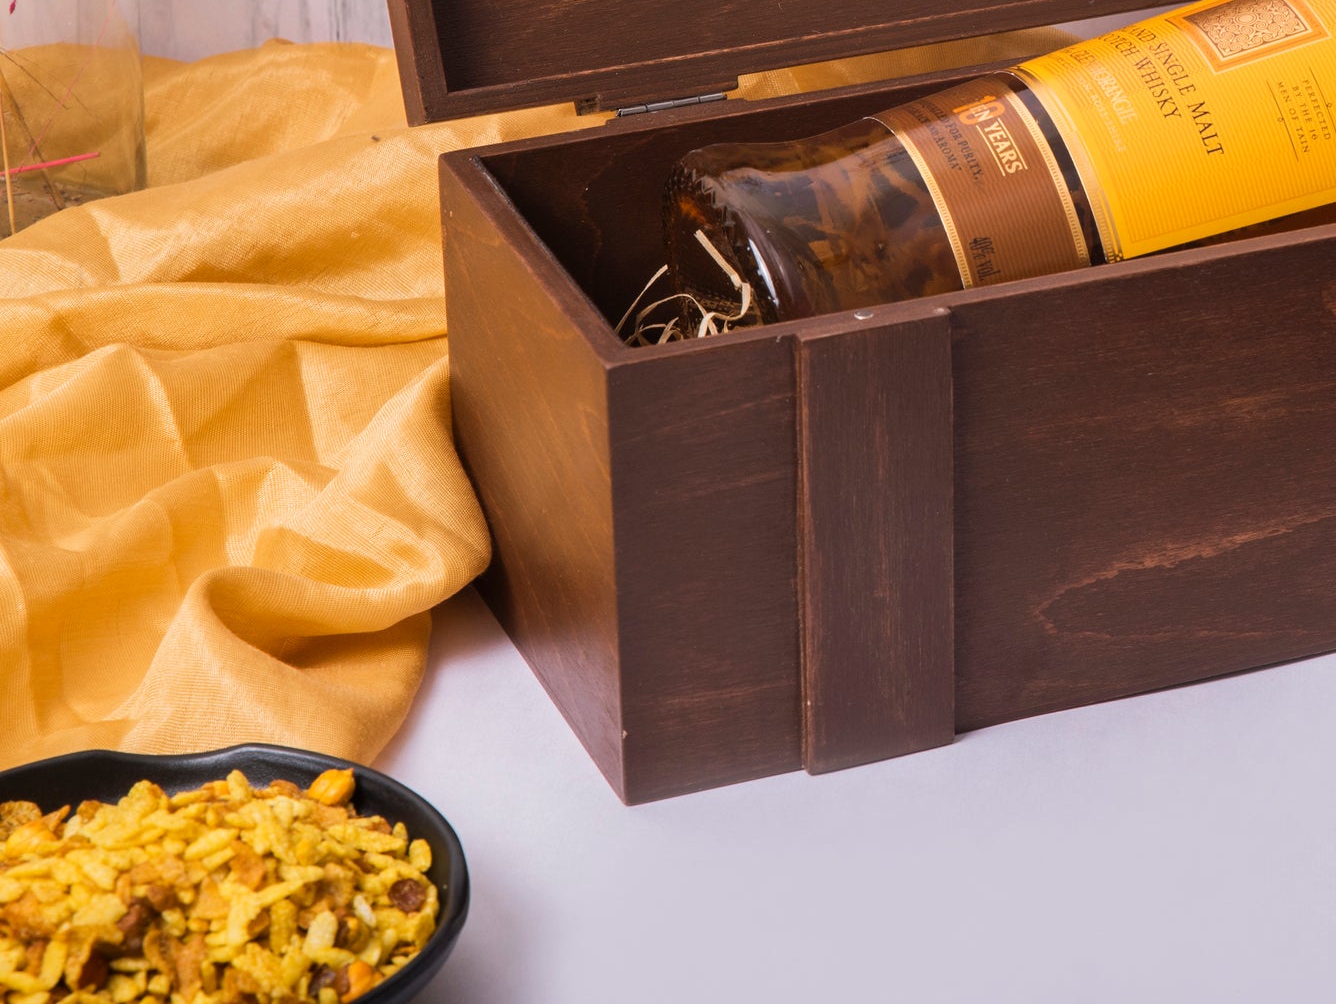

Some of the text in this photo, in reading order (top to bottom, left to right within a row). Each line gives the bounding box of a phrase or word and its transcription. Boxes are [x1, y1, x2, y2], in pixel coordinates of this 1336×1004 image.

[1134, 56, 1182, 119] WHISKY
[1150, 42, 1197, 96] SINGLE
[1187, 101, 1225, 156] MALT
[1277, 81, 1310, 153] MEN OF TAIN
[1292, 85, 1319, 141] BY THE 16
[1303, 79, 1332, 140] PERFECTED
[983, 121, 1023, 175] YEARS
